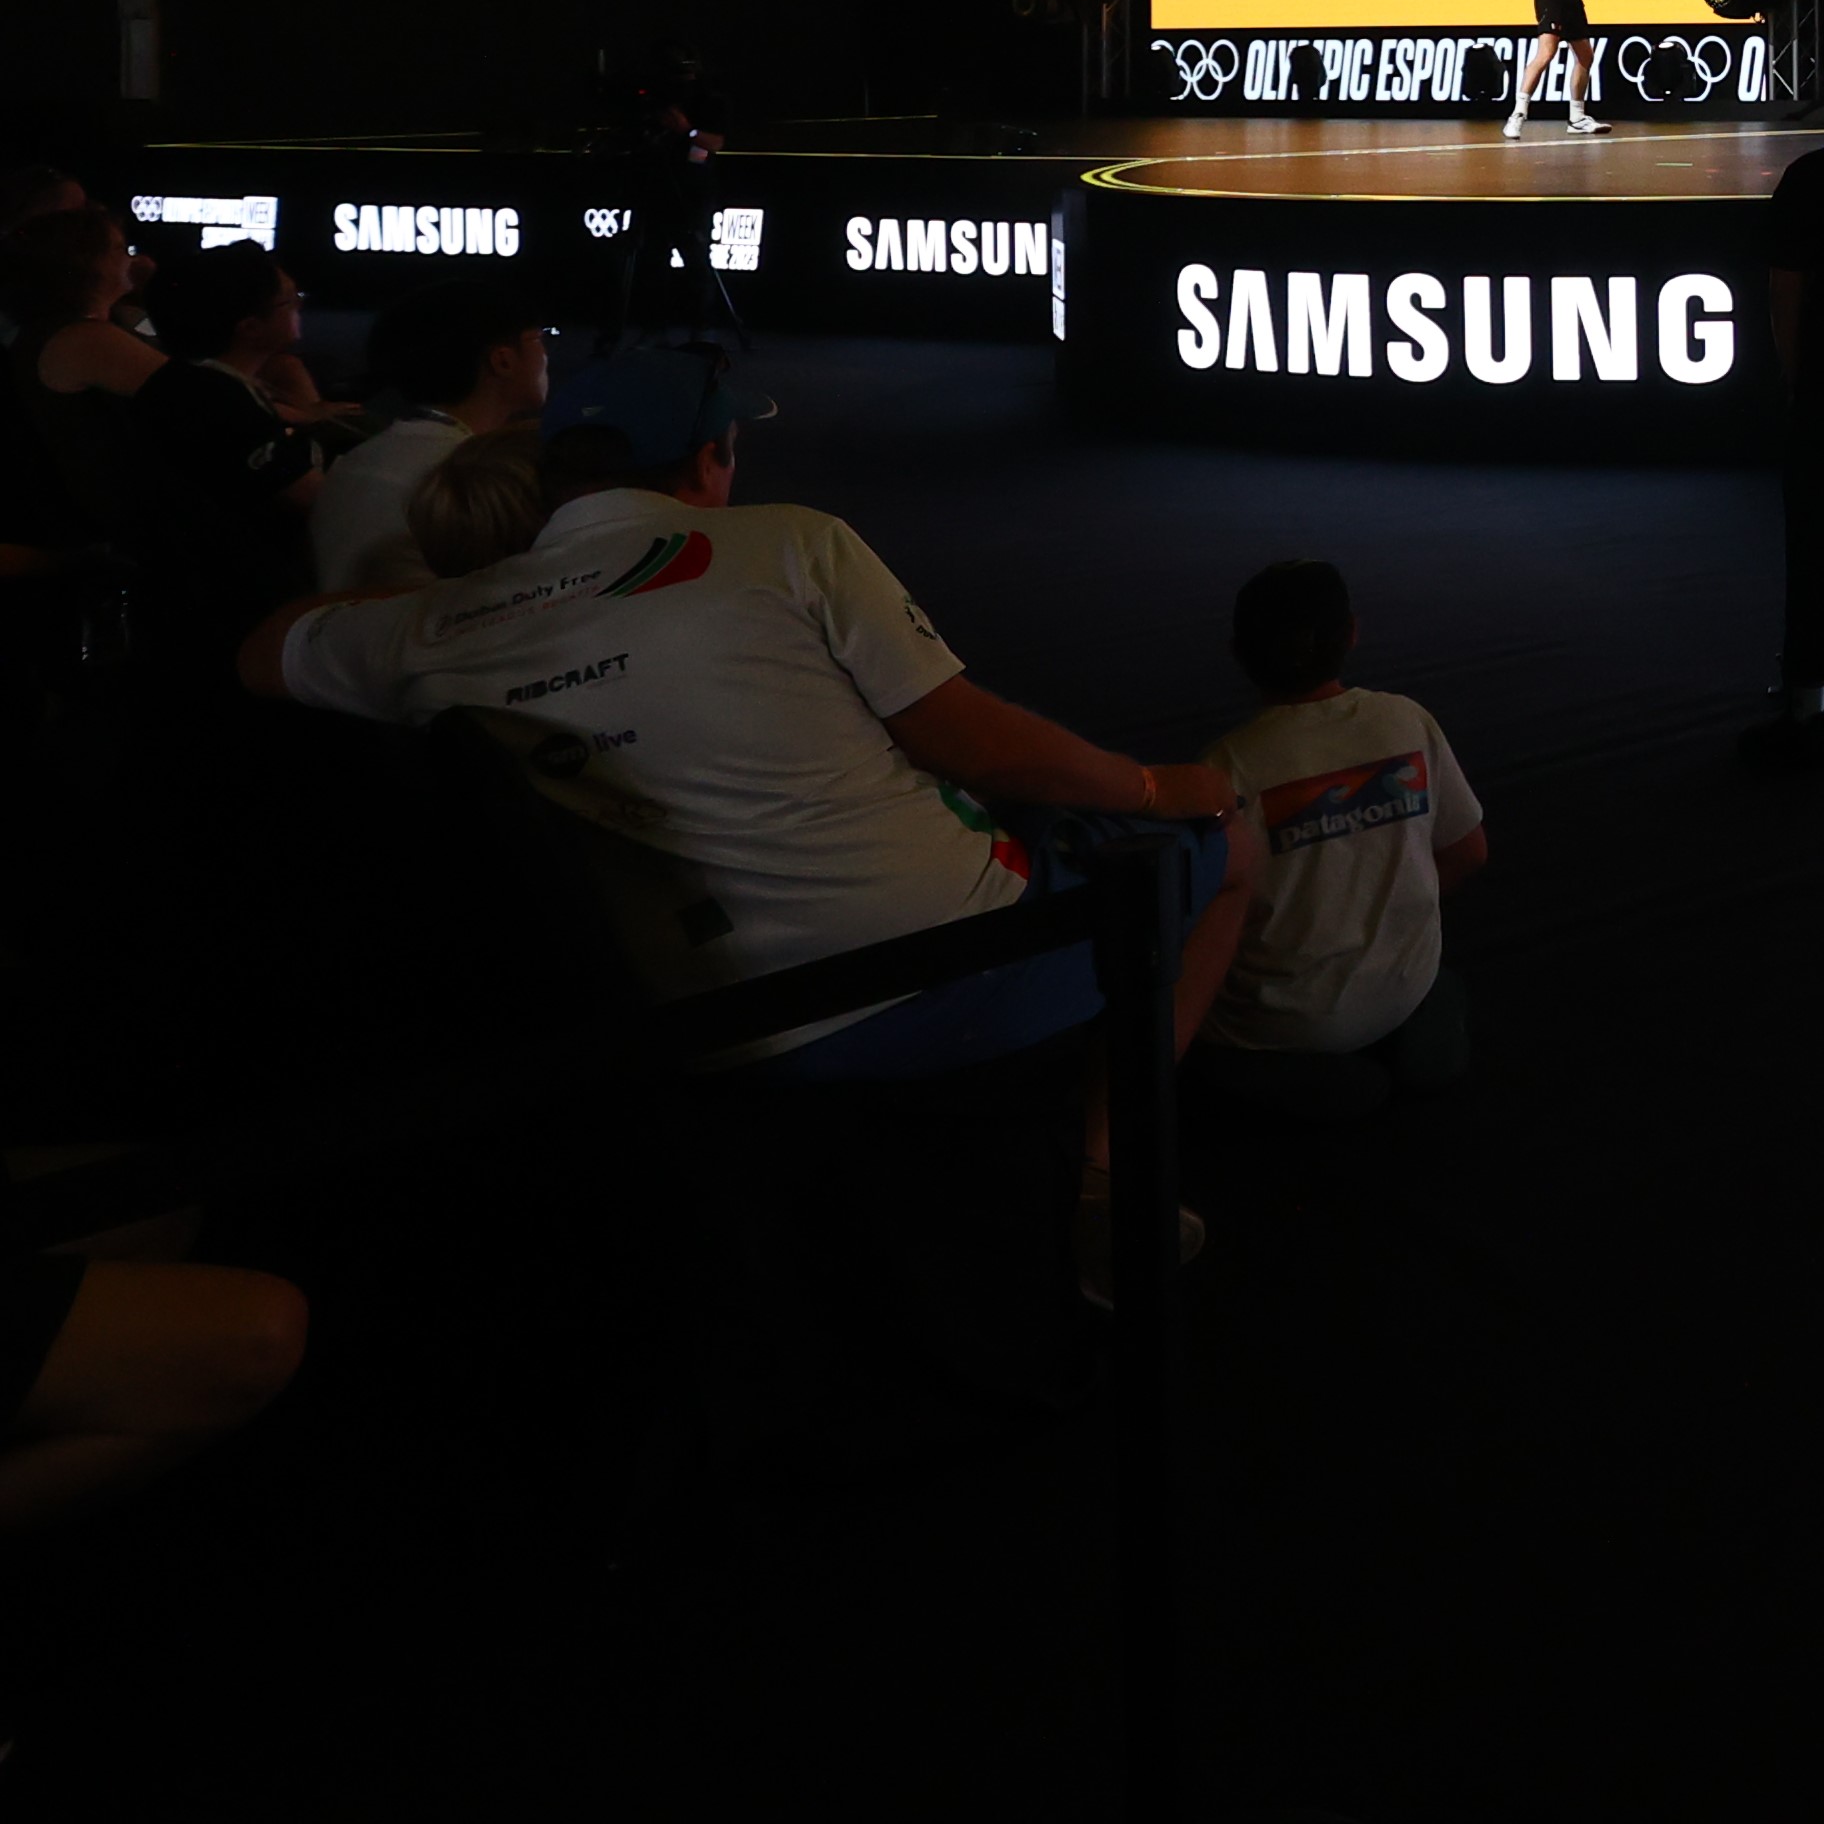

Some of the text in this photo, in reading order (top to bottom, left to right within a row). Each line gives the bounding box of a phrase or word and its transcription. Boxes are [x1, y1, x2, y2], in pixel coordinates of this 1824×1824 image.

[334, 203, 519, 256] SAMSUNG
[726, 212, 759, 241] WEEK
[846, 216, 1048, 276] SAMSUN
[1176, 263, 1734, 383] SAMSUNG
[511, 584, 554, 606] Duty
[505, 652, 629, 706] RIBCRAFT
[592, 729, 638, 754] live
